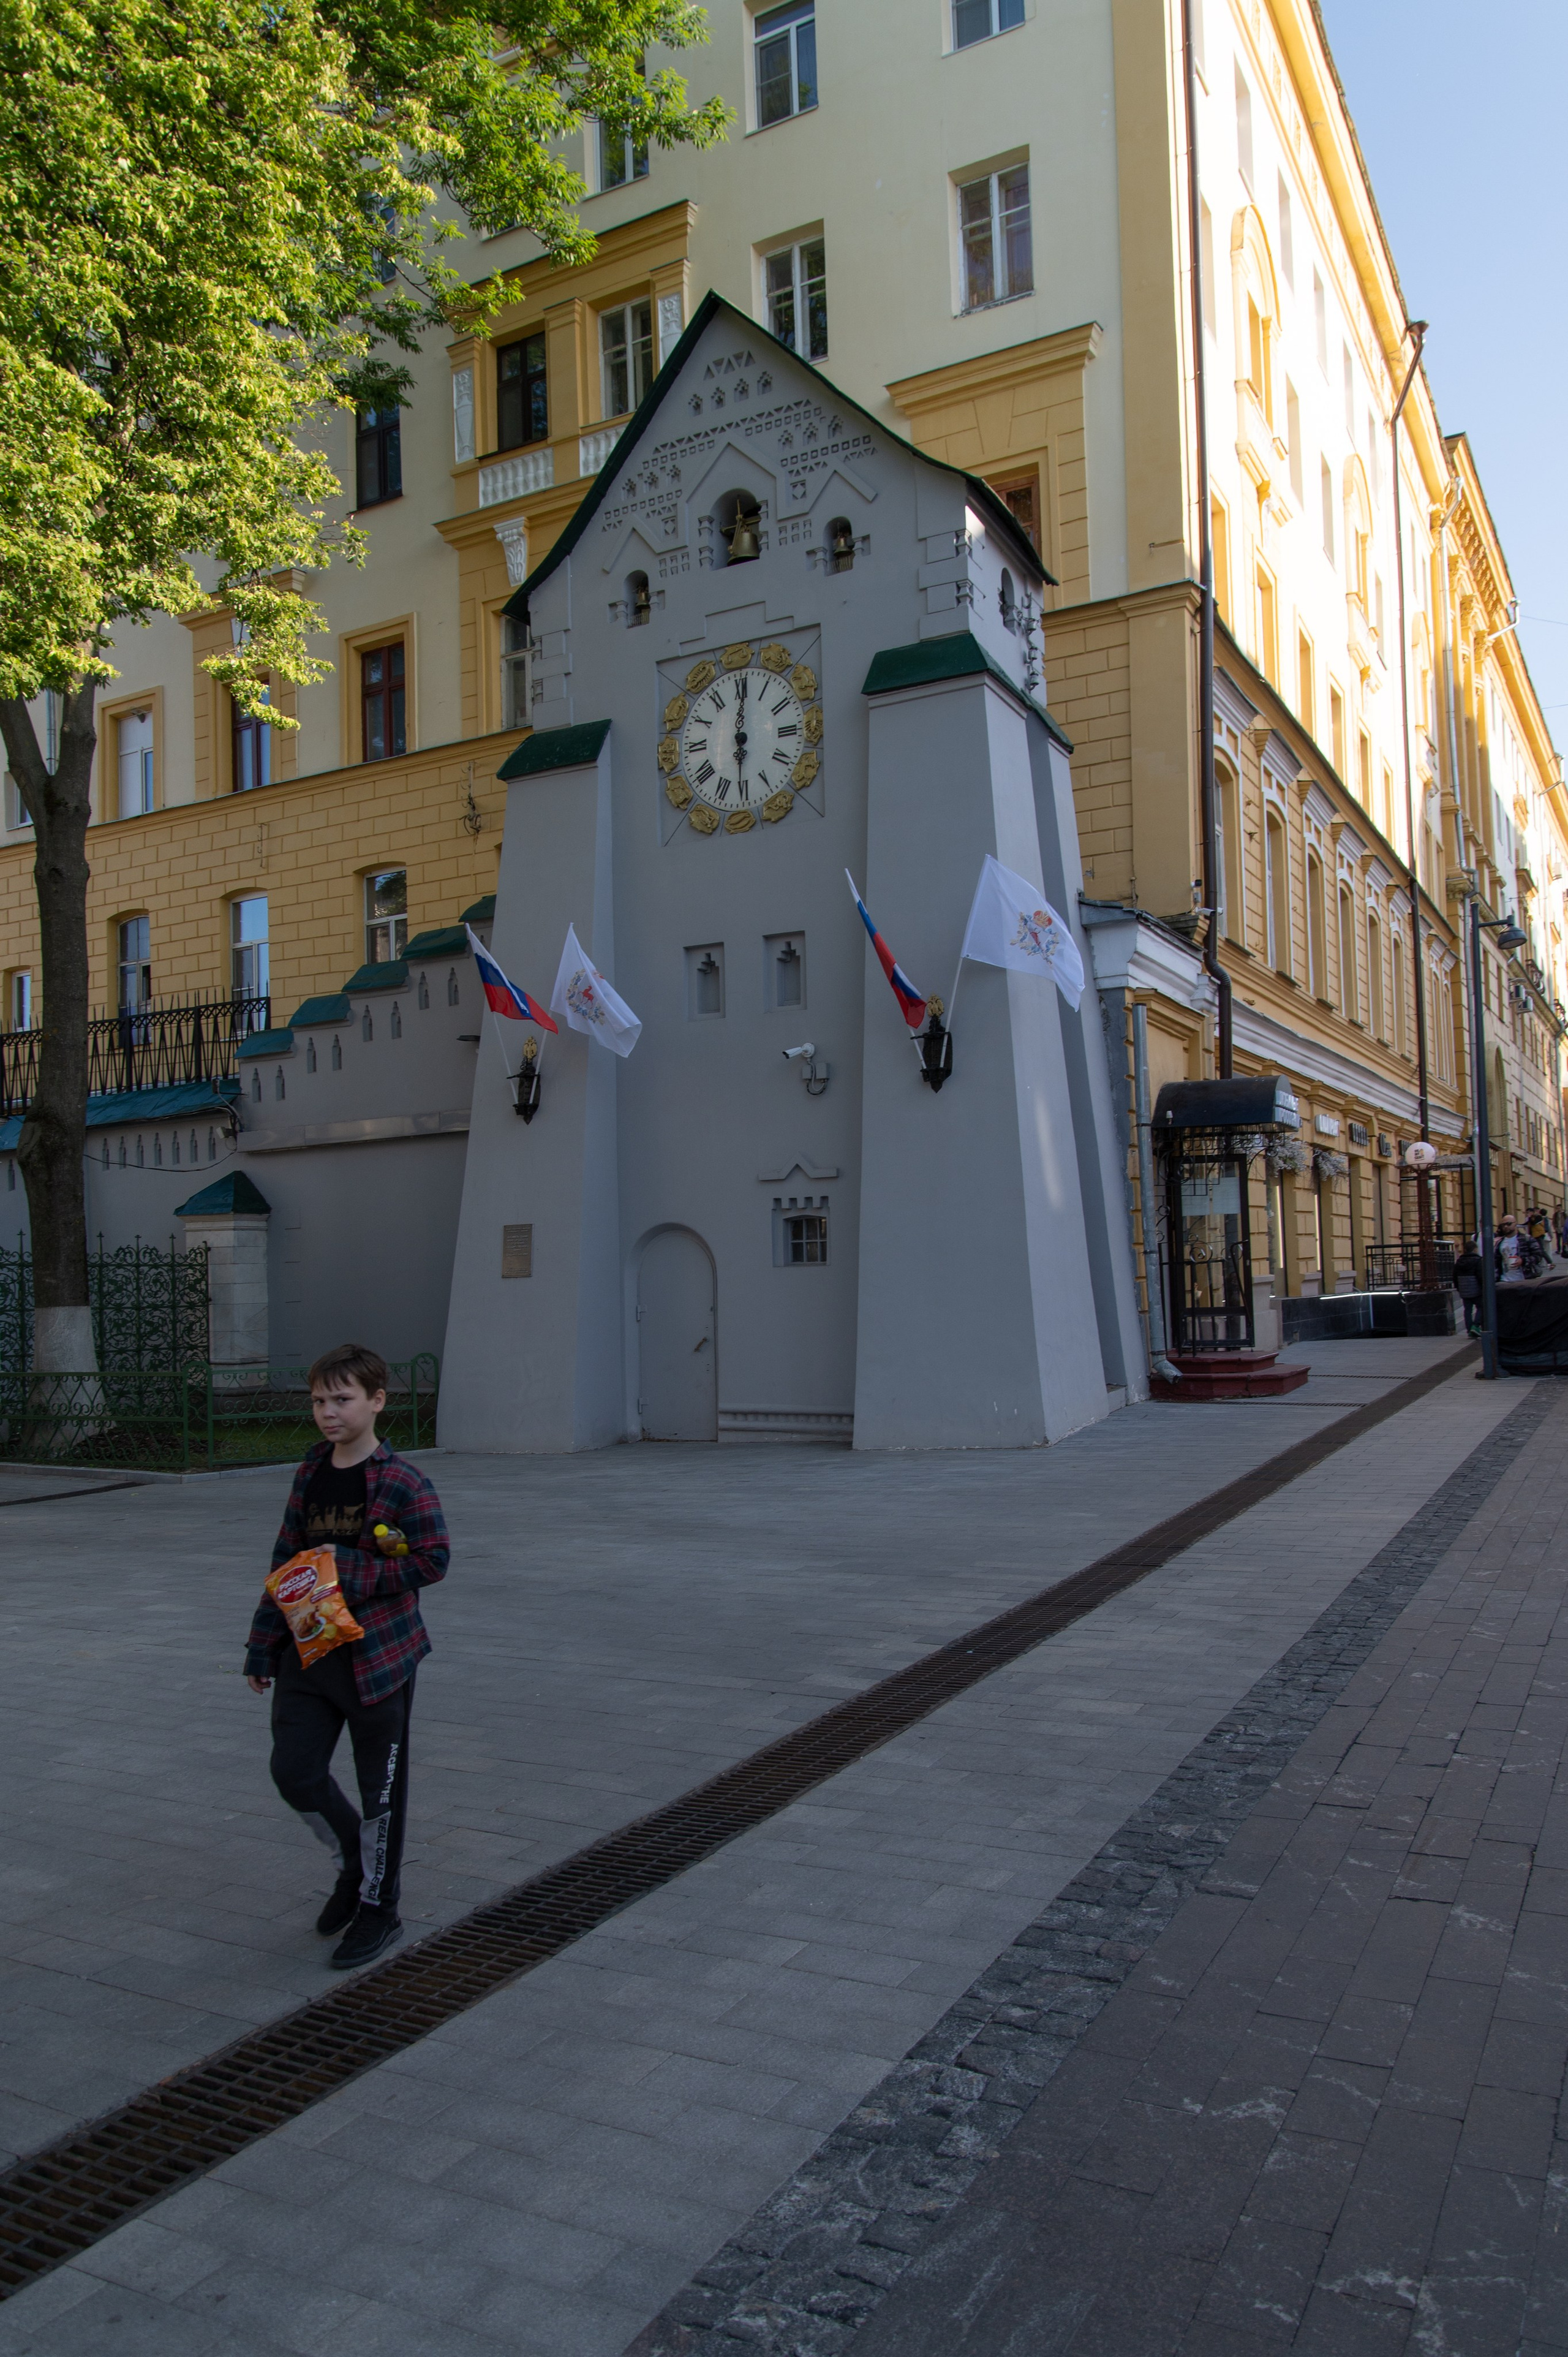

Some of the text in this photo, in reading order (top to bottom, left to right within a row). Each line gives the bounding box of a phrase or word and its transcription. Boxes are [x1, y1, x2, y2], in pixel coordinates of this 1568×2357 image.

[734, 677, 747, 700] XII
[758, 681, 769, 701] I
[709, 690, 726, 713] XI
[771, 696, 790, 716] II
[694, 715, 713, 728] X
[778, 724, 797, 738] III
[689, 738, 707, 754] IX
[772, 747, 791, 766] IV
[695, 759, 715, 785] VIII
[758, 770, 771, 789] V
[715, 776, 731, 801] VII
[737, 779, 748, 801] VI
[277, 1575, 316, 1598] КАРТОШКА
[279, 1569, 312, 1592] РУССКАЯ
[379, 1784, 391, 1804] THE
[377, 1818, 386, 1844] REAL
